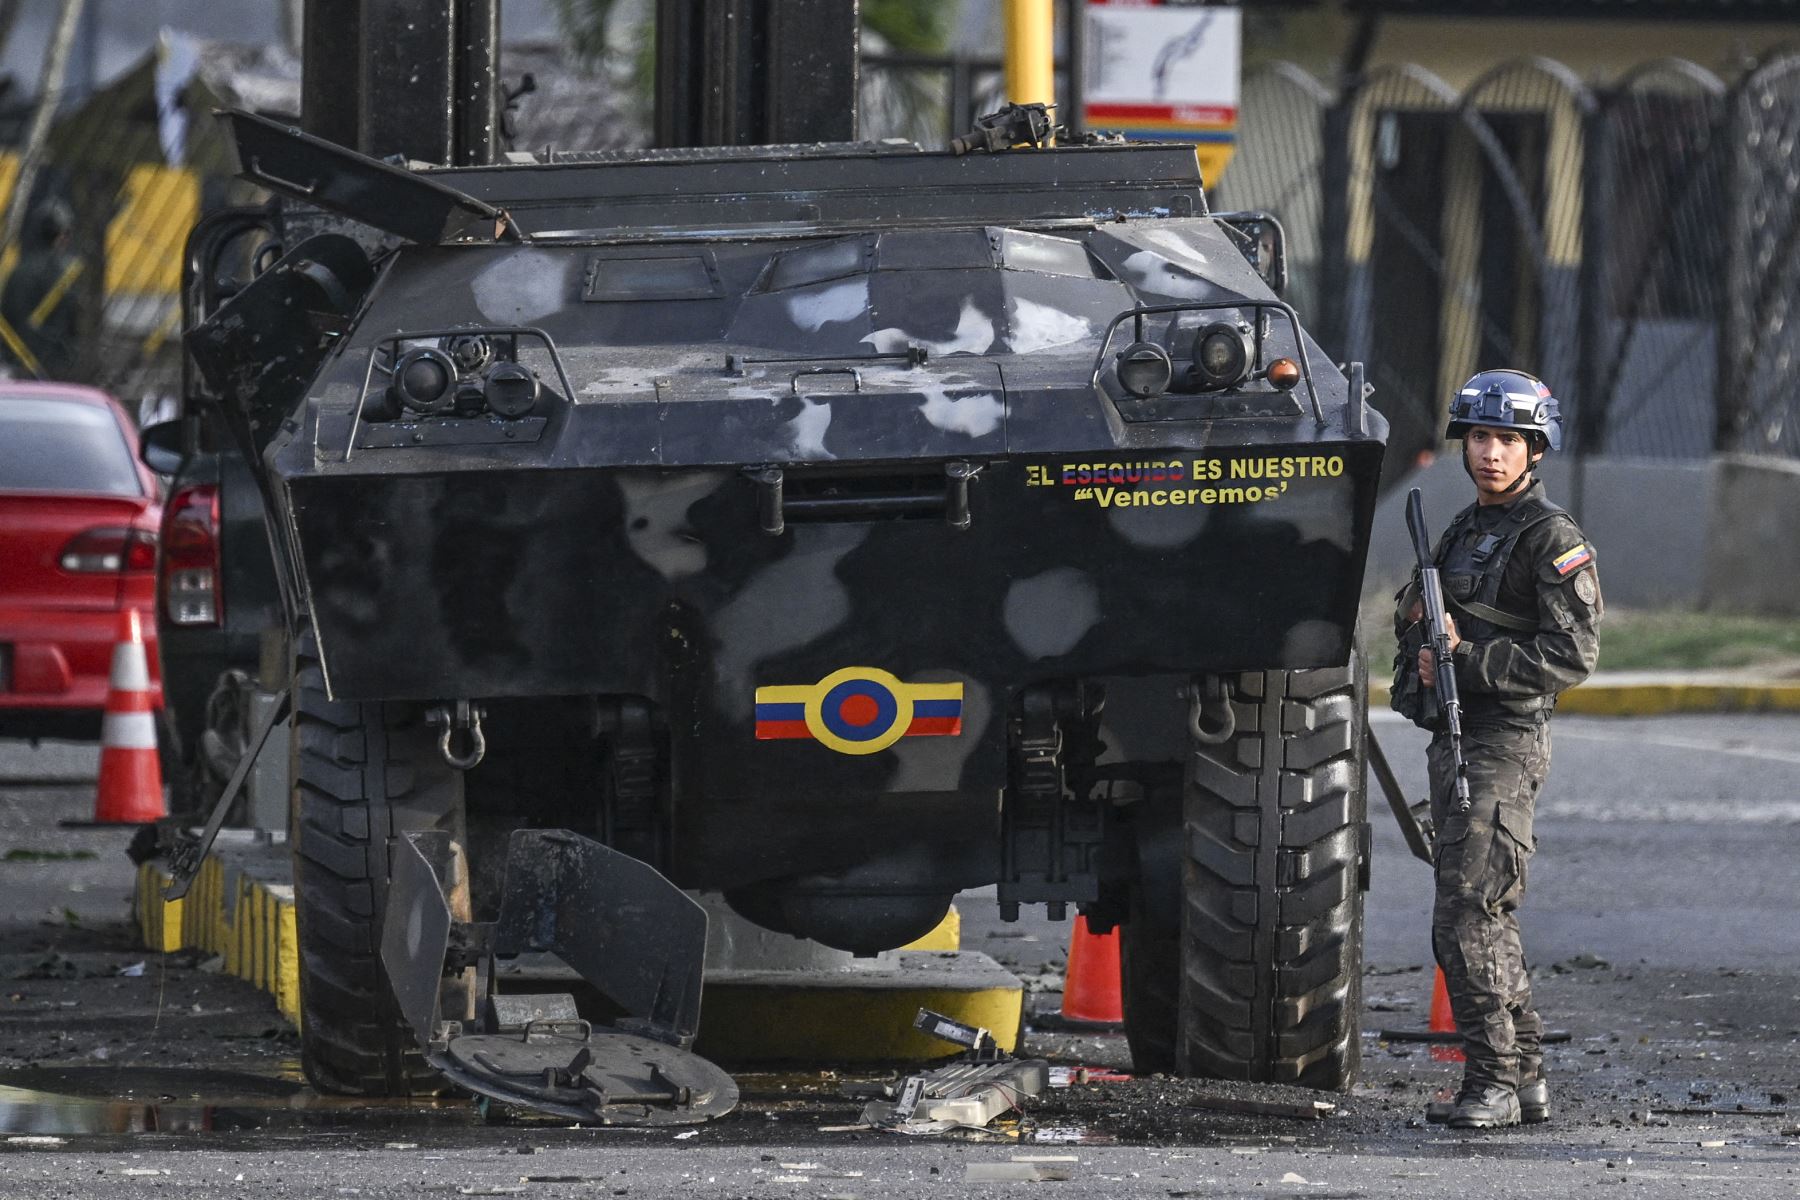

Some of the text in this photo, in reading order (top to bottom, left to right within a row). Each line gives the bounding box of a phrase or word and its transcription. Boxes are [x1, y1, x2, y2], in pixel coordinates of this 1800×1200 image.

[1026, 456, 1344, 486] EL ESEQUIBO ES NUESTRO
